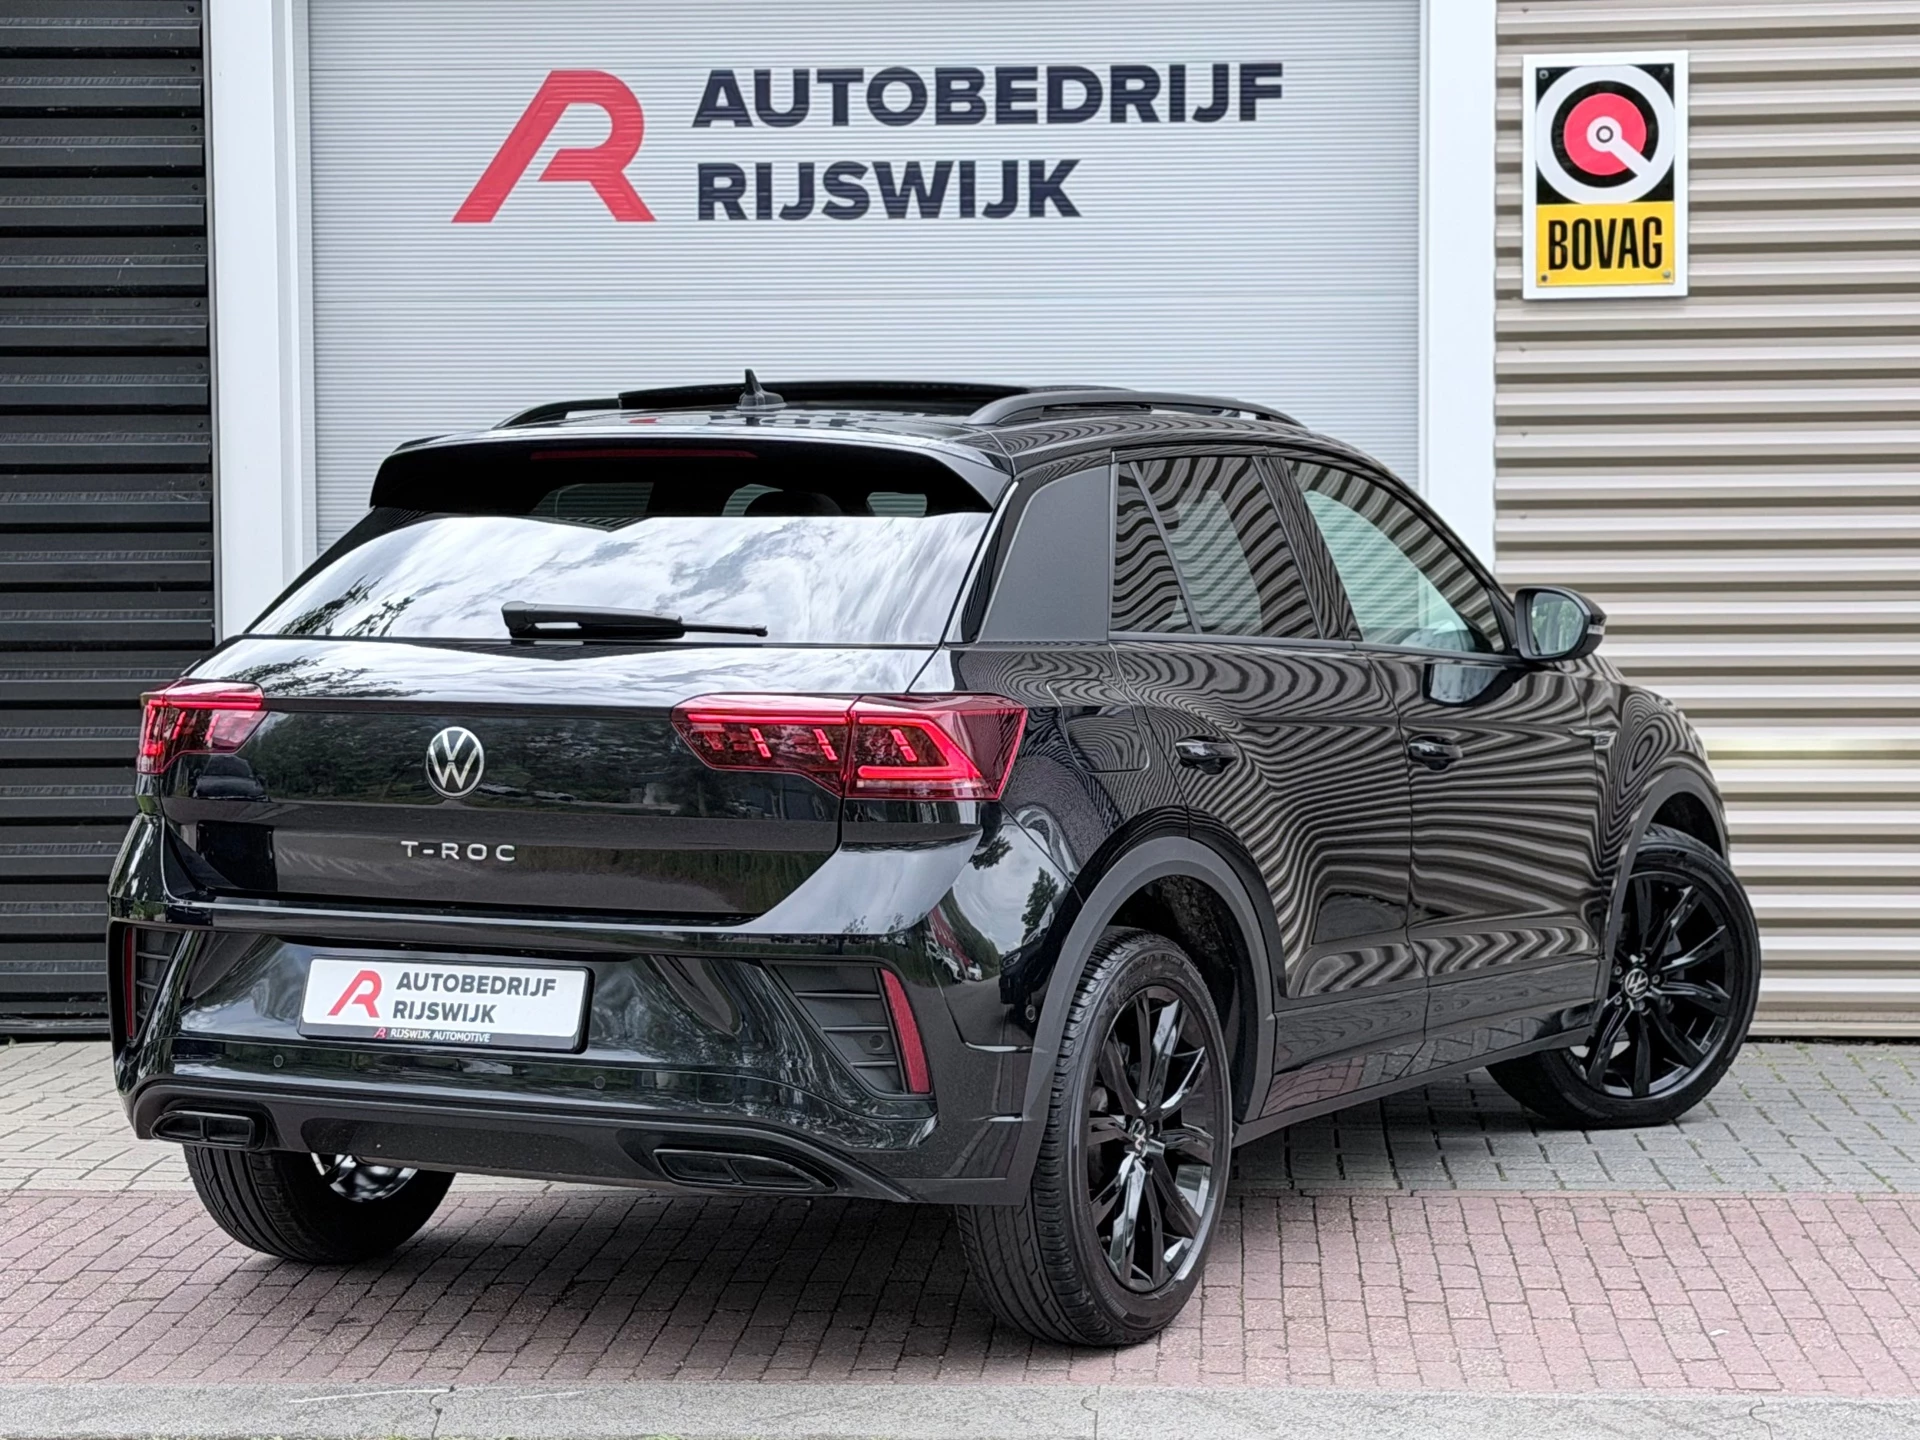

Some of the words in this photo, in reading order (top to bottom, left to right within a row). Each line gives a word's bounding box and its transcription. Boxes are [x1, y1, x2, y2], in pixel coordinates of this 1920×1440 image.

[692, 62, 1284, 128] AUTOBEDRIJF
[697, 159, 1082, 222] RIJSWIJK
[1548, 216, 1663, 271] BOVAG
[400, 840, 516, 862] T-ROC
[396, 971, 557, 997] AUTOBEDRIJF
[393, 1000, 498, 1024] RIJSWIJK
[390, 1028, 431, 1040] RIJSWIJK
[432, 1030, 491, 1043] AUTOMOTIVE
